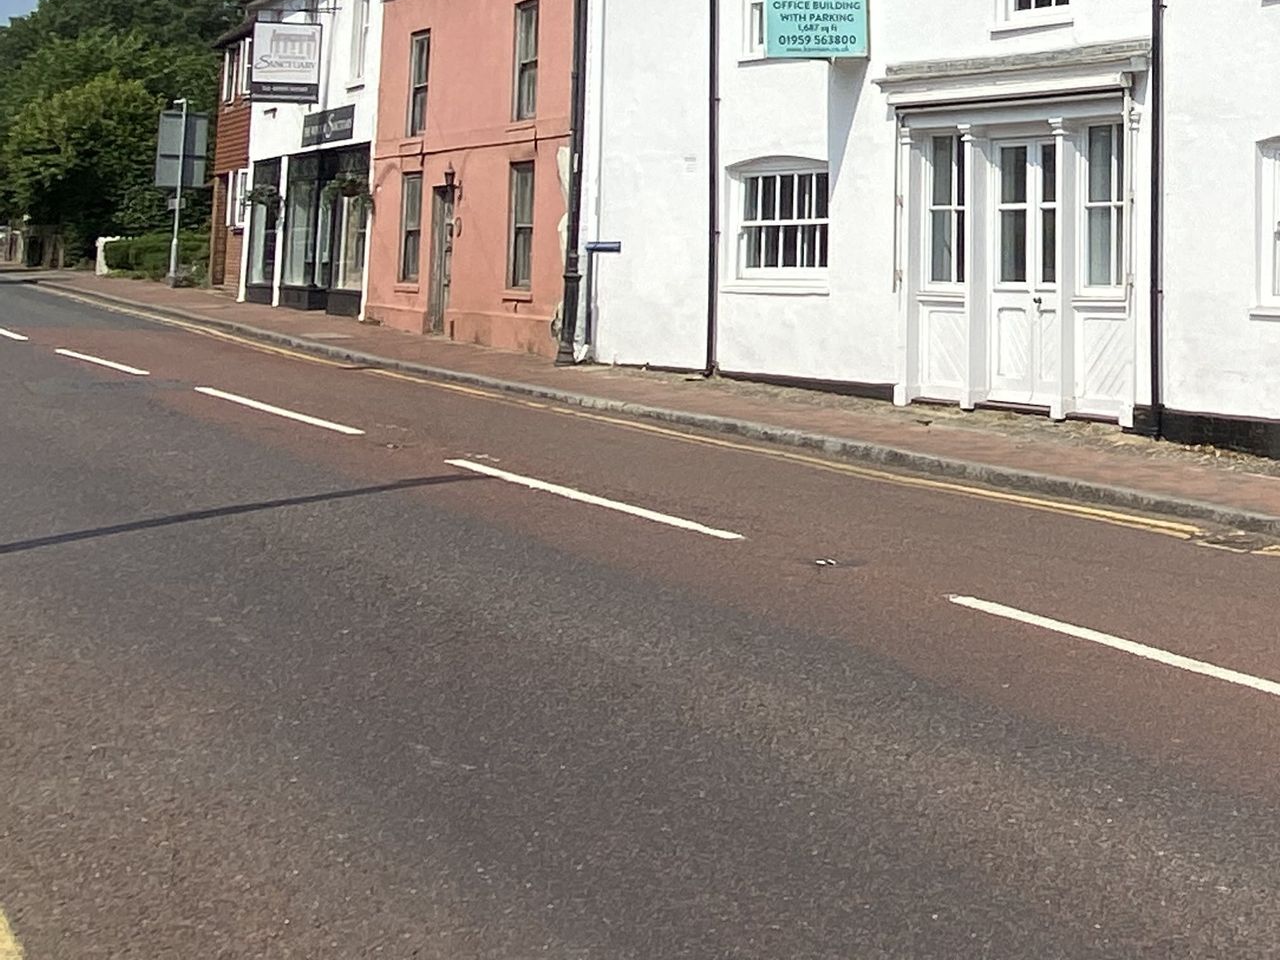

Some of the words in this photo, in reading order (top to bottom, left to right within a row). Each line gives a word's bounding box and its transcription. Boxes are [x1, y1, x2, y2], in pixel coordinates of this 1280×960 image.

[773, 1, 810, 9] OFFICE
[813, 1, 861, 10] BUILDING
[809, 14, 854, 22] PARKING
[779, 35, 811, 45] 01959
[814, 35, 856, 45] 563800
